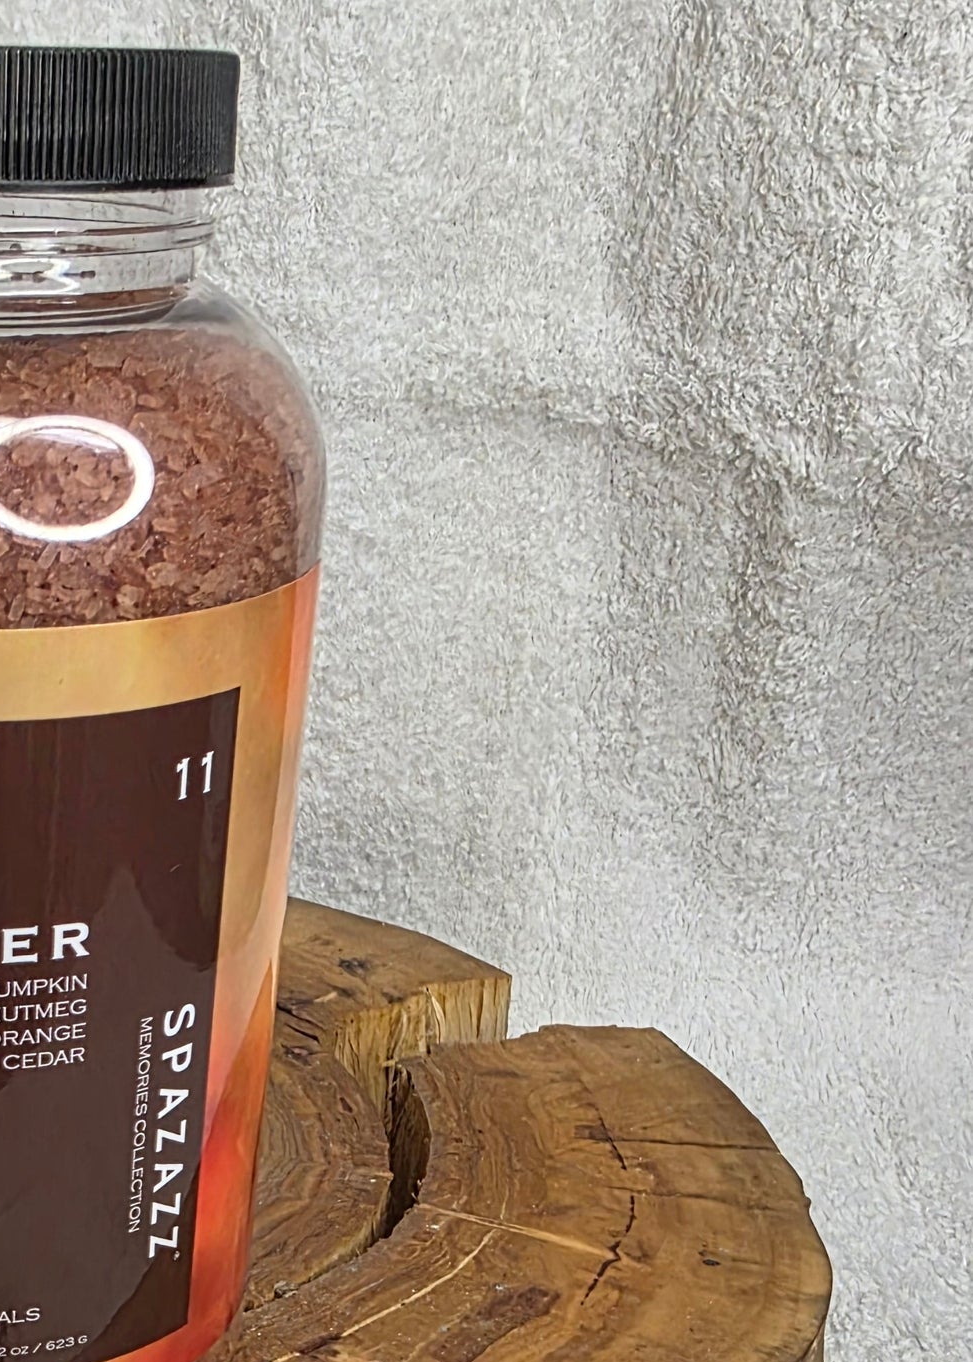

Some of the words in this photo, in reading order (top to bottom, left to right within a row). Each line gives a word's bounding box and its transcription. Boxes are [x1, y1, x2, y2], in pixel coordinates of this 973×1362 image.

[176, 750, 215, 800] 11
[2, 1046, 86, 1070] CEDAR
[134, 1016, 154, 1117] MEMORIES
[127, 1119, 147, 1234] COLLECTION
[10, 1345, 29, 1356] OZ
[33, 1342, 42, 1354] /
[45, 1336, 75, 1351] 623
[77, 1334, 88, 1344] G
